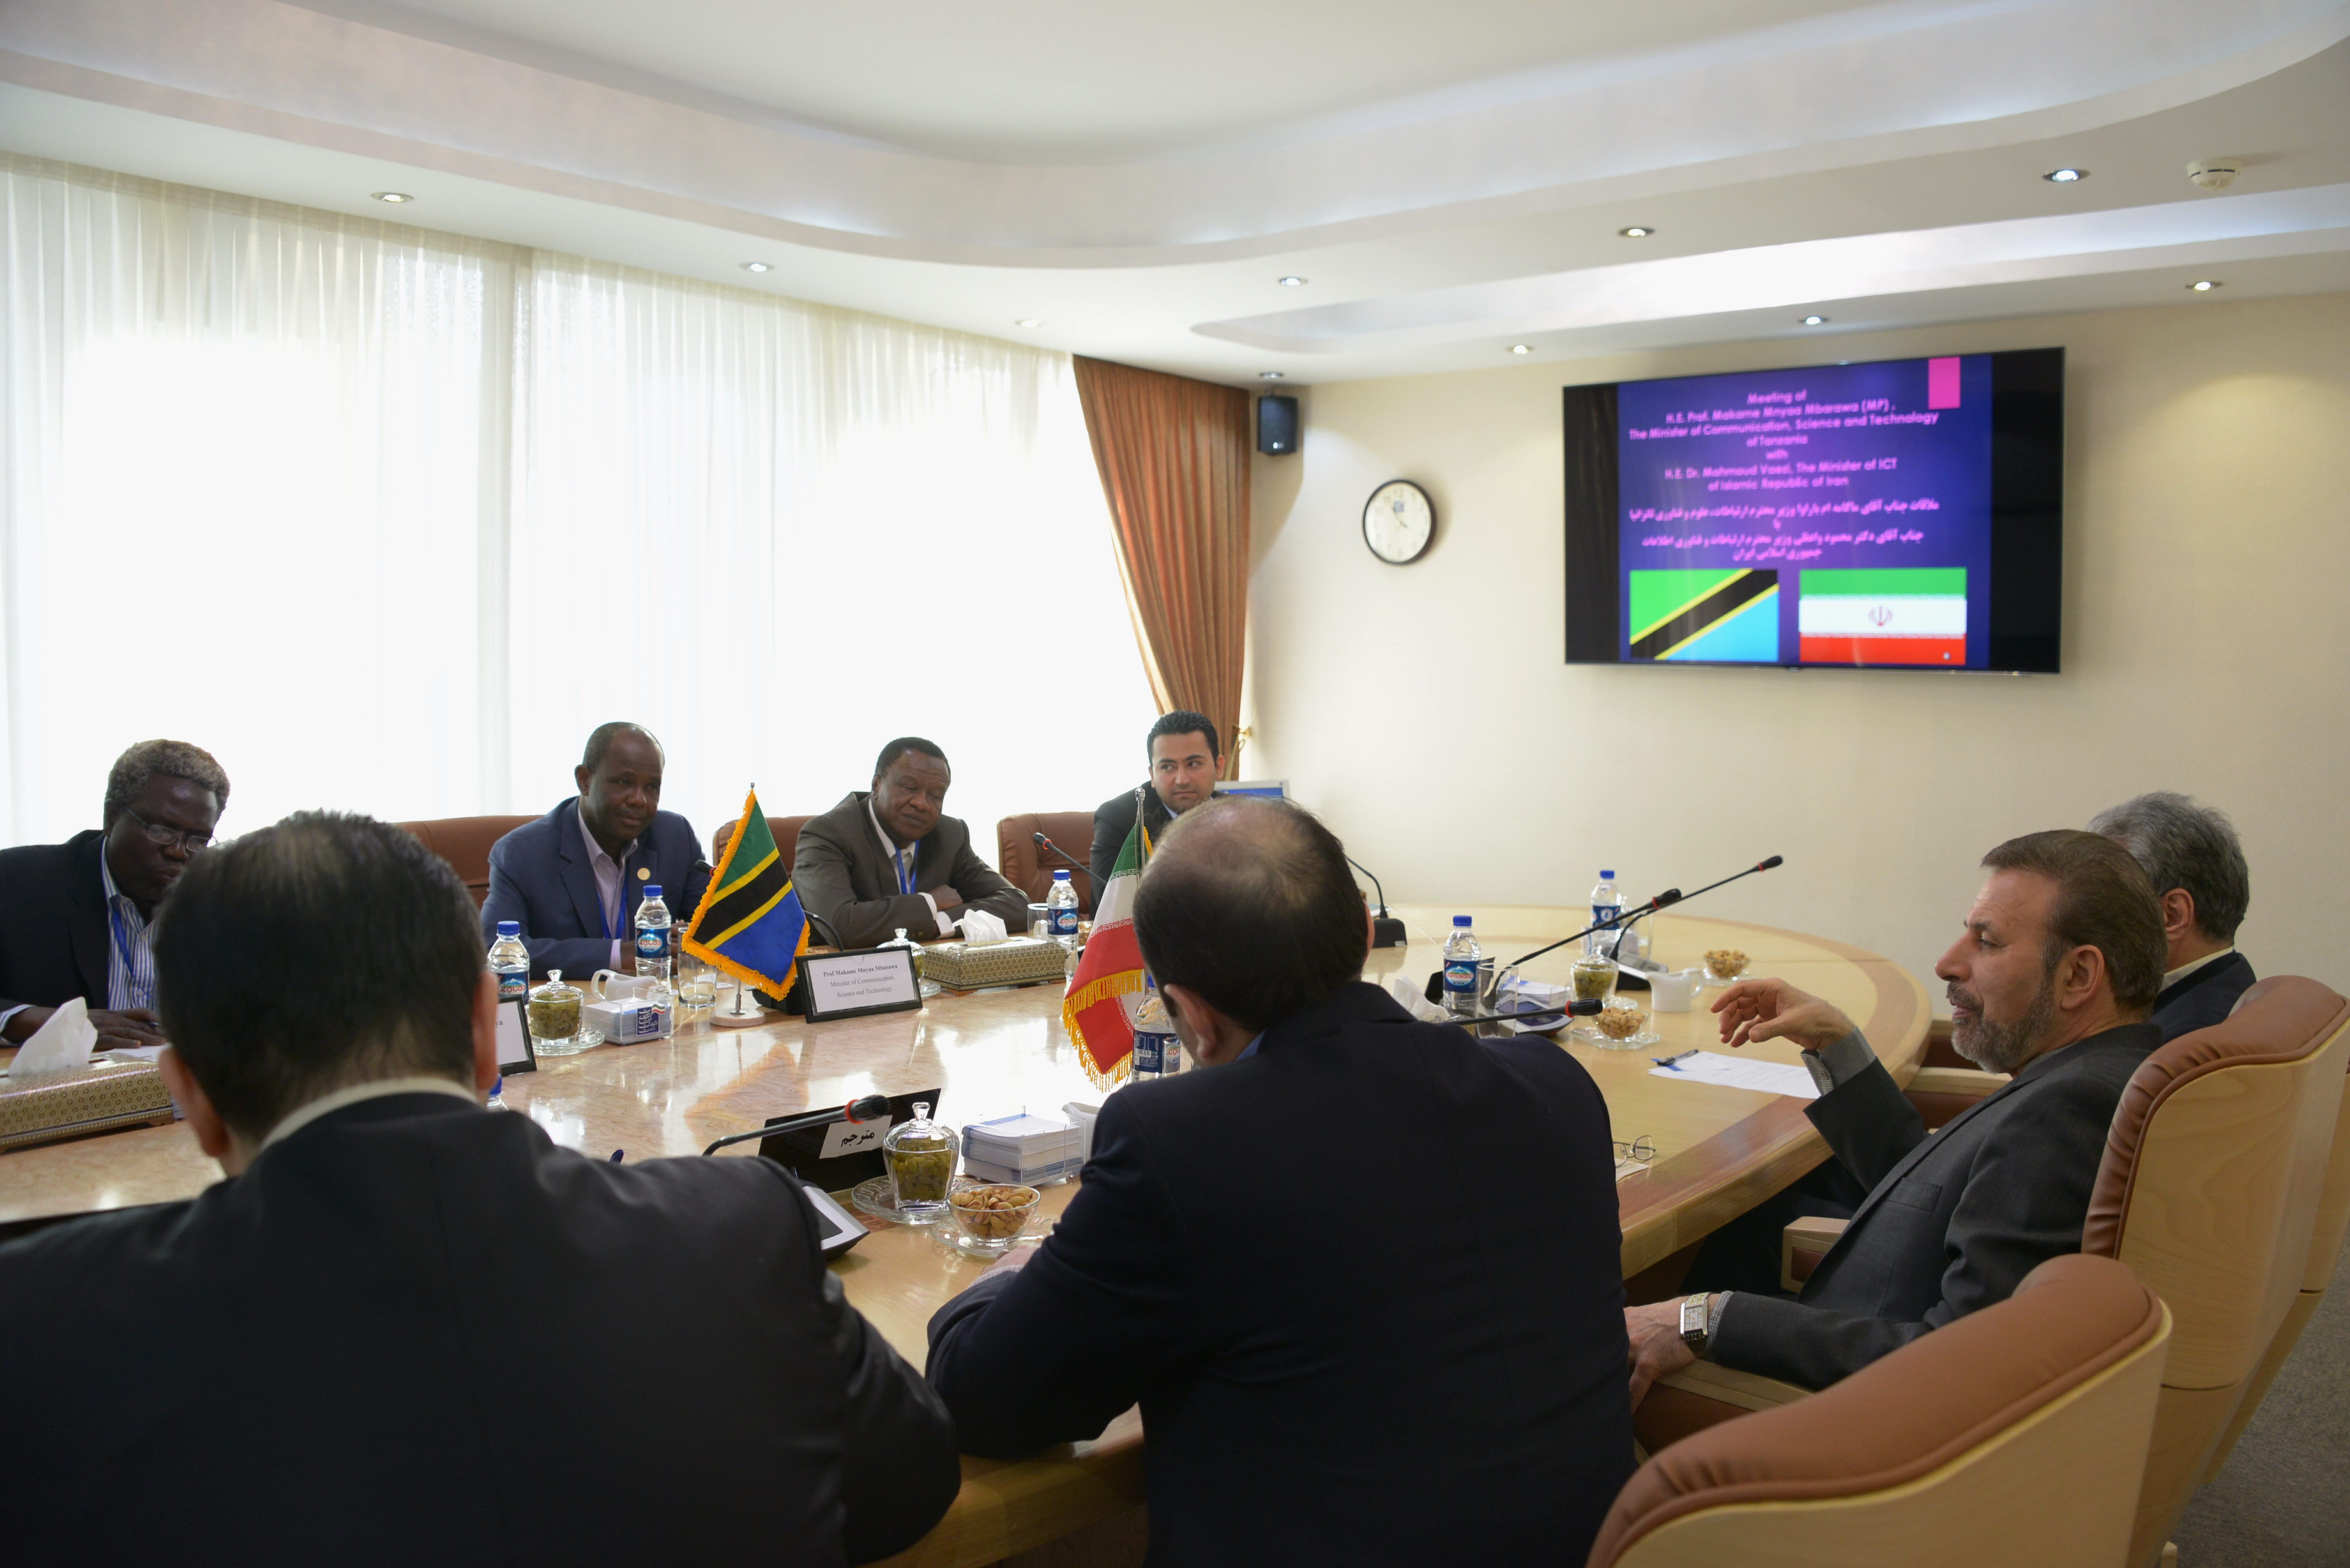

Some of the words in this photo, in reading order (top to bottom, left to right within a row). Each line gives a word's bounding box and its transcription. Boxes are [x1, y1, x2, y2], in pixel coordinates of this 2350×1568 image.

[1747, 391, 1793, 404] Meeting
[1794, 388, 1807, 402] of
[1712, 408, 1761, 421] Makame
[1805, 402, 1860, 415] Mbarawa
[1861, 397, 1890, 412] (MP)
[1629, 428, 1648, 440] The
[1649, 426, 1689, 439] Minister
[1690, 424, 1702, 437] of
[1796, 418, 1842, 429] Science
[1844, 414, 1867, 427] and
[1869, 411, 1939, 425] Technology
[1747, 435, 1758, 447] of
[1760, 433, 1808, 446] Tanzania
[1766, 449, 1789, 460] with
[1702, 464, 1758, 478] Mahmoud
[1797, 462, 1817, 473] The
[1818, 459, 1862, 472] Minister
[1864, 458, 1877, 471] of
[1879, 456, 1898, 470] ICT
[1708, 479, 1720, 492] of
[1720, 479, 1758, 490] Islamic
[1761, 476, 1809, 490] Republic
[1812, 475, 1824, 487] of
[1826, 476, 1849, 487] Iran
[830, 979, 851, 988] Minister
[857, 975, 895, 984] Communication,
[840, 1129, 876, 1148] مترجم
